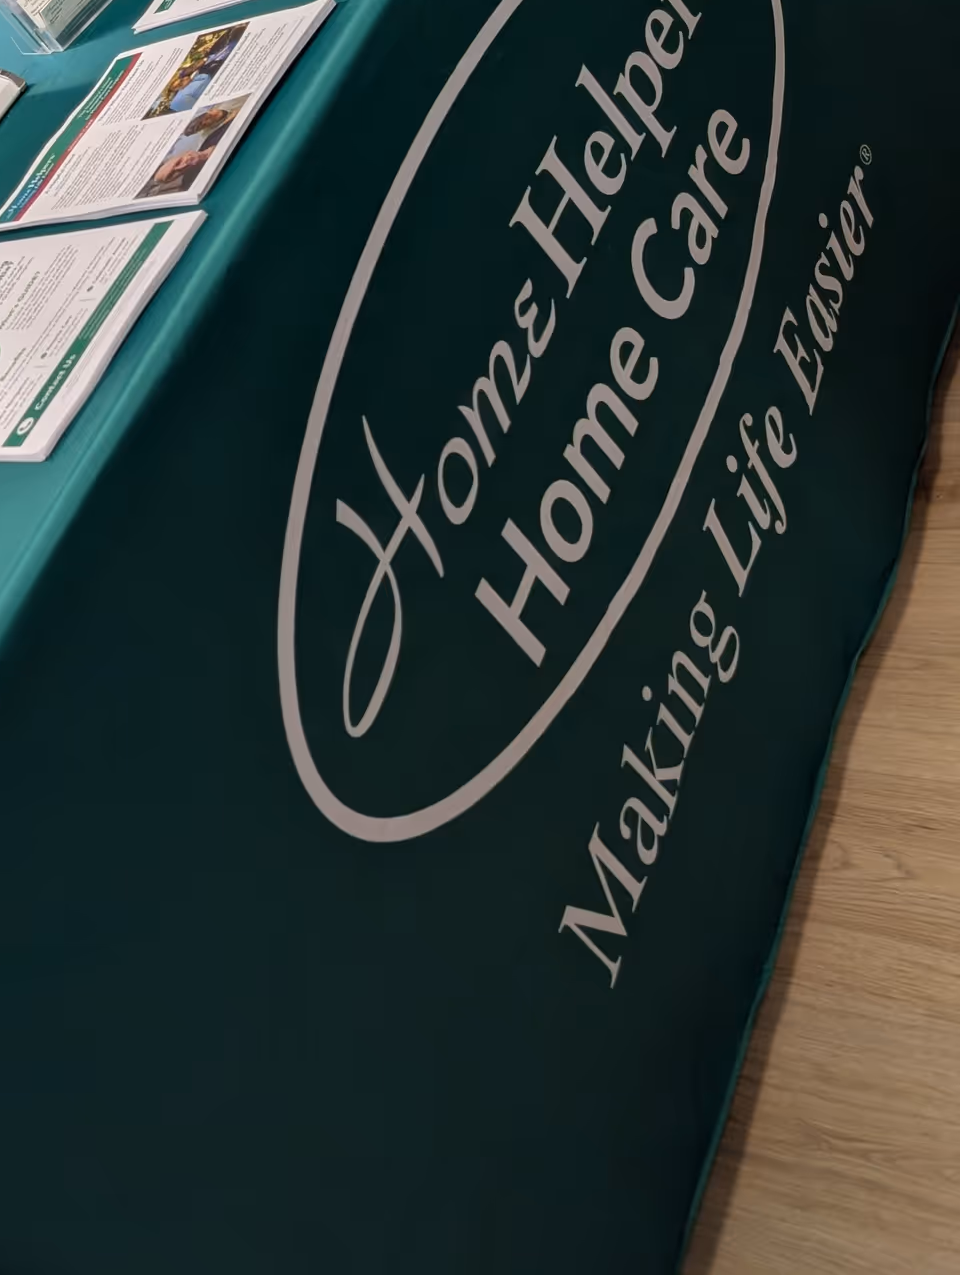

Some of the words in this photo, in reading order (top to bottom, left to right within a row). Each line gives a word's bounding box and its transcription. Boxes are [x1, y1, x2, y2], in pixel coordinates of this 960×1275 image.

[34, 369, 66, 409] Contact
[62, 353, 77, 367] Us
[336, 279, 555, 737] Home
[475, 325, 659, 666] Home
[630, 108, 750, 319] Care
[558, 591, 741, 987] Making
[702, 413, 798, 563] Life
